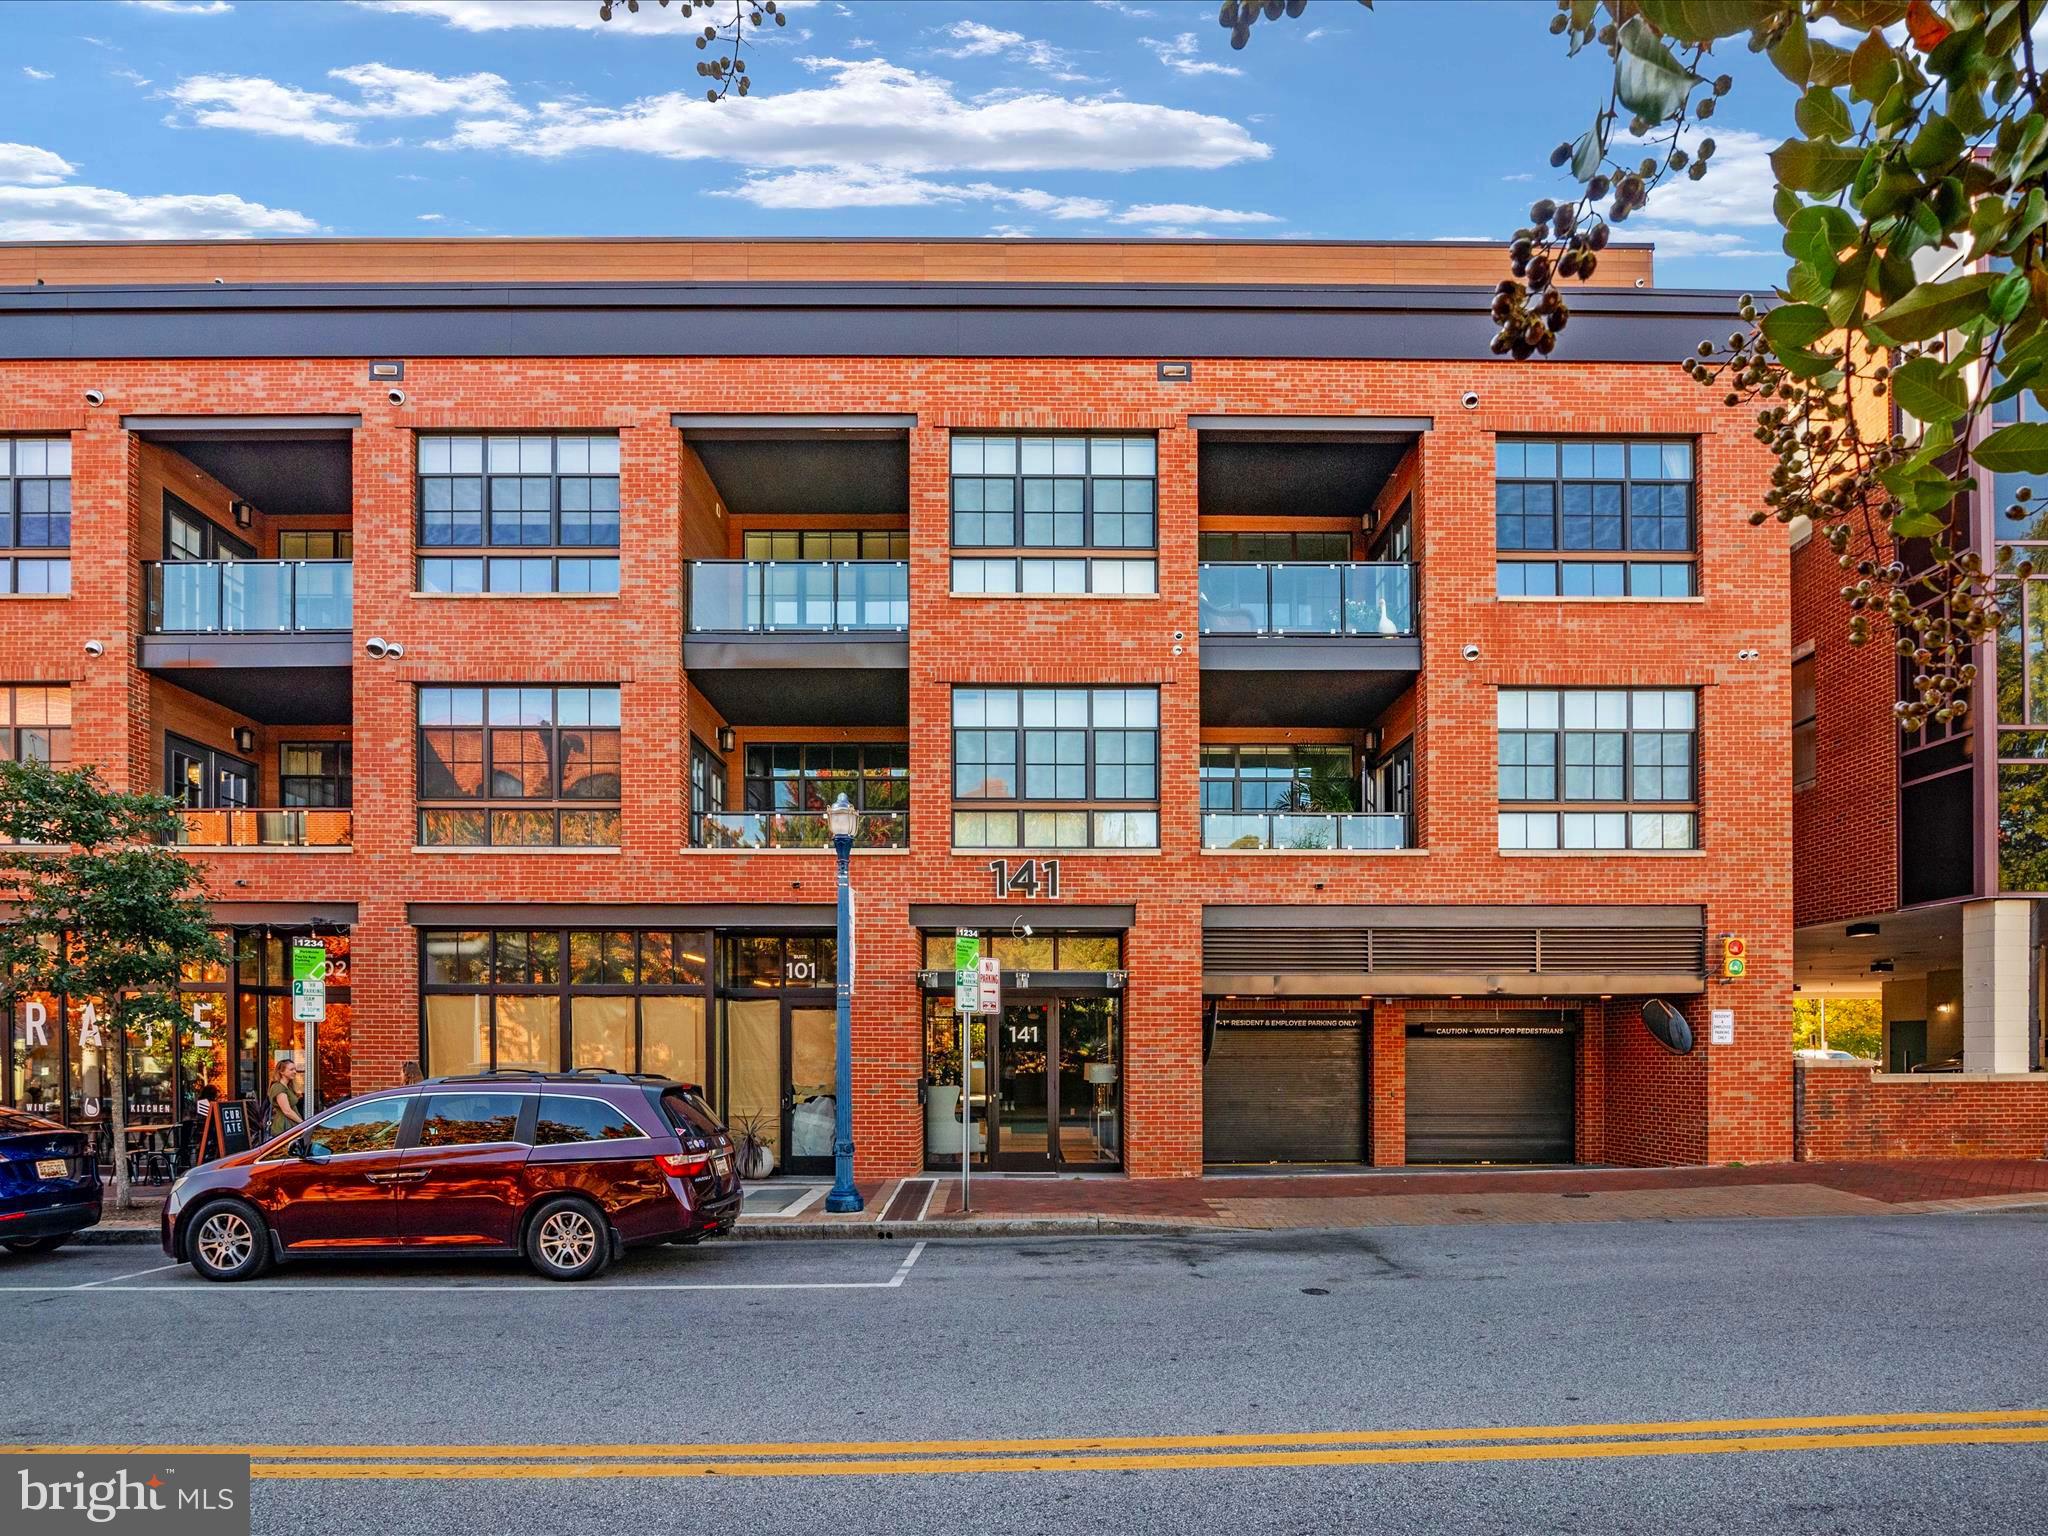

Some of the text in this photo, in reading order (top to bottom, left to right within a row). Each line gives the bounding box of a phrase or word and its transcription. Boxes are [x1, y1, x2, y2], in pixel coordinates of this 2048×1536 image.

[989, 859, 1060, 899] 141
[325, 960, 347, 977] 02
[786, 962, 816, 979] 101
[985, 962, 994, 972] NO
[980, 973, 999, 984] PARKING
[295, 982, 302, 994] 2
[1009, 1026, 1038, 1043] 141
[26, 1103, 50, 1112] WINE
[130, 1104, 170, 1113] KITCHEN
[224, 1109, 240, 1120] CUR
[226, 1122, 242, 1133] ATE
